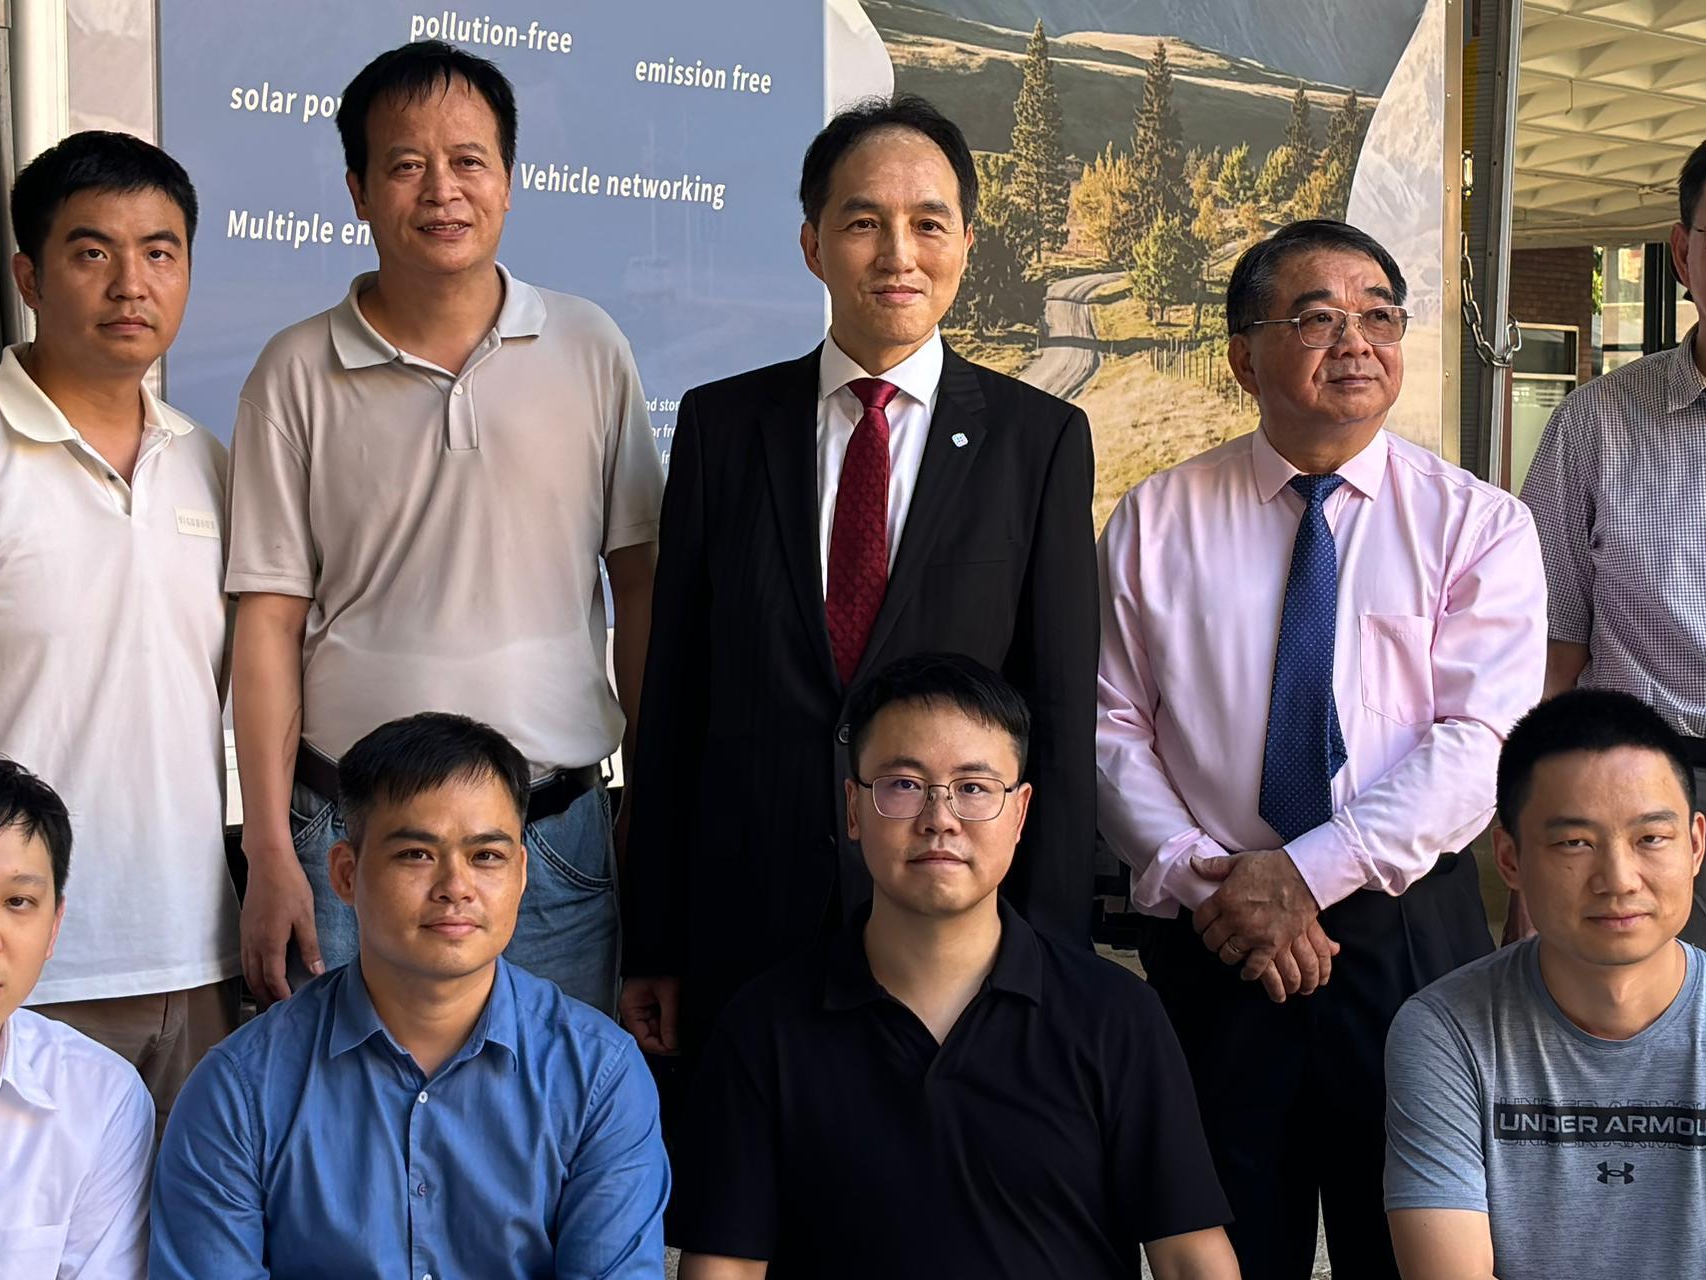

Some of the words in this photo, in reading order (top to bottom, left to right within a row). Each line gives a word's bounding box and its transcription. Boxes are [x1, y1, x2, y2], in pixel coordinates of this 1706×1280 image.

[409, 11, 573, 54] pollution-free
[635, 57, 726, 90] emission
[732, 65, 772, 94] free
[230, 82, 297, 114] solar
[521, 163, 600, 195] Vehicle
[606, 174, 726, 211] networking
[227, 209, 334, 249] Multiple
[1499, 1112, 1599, 1135] UNDER
